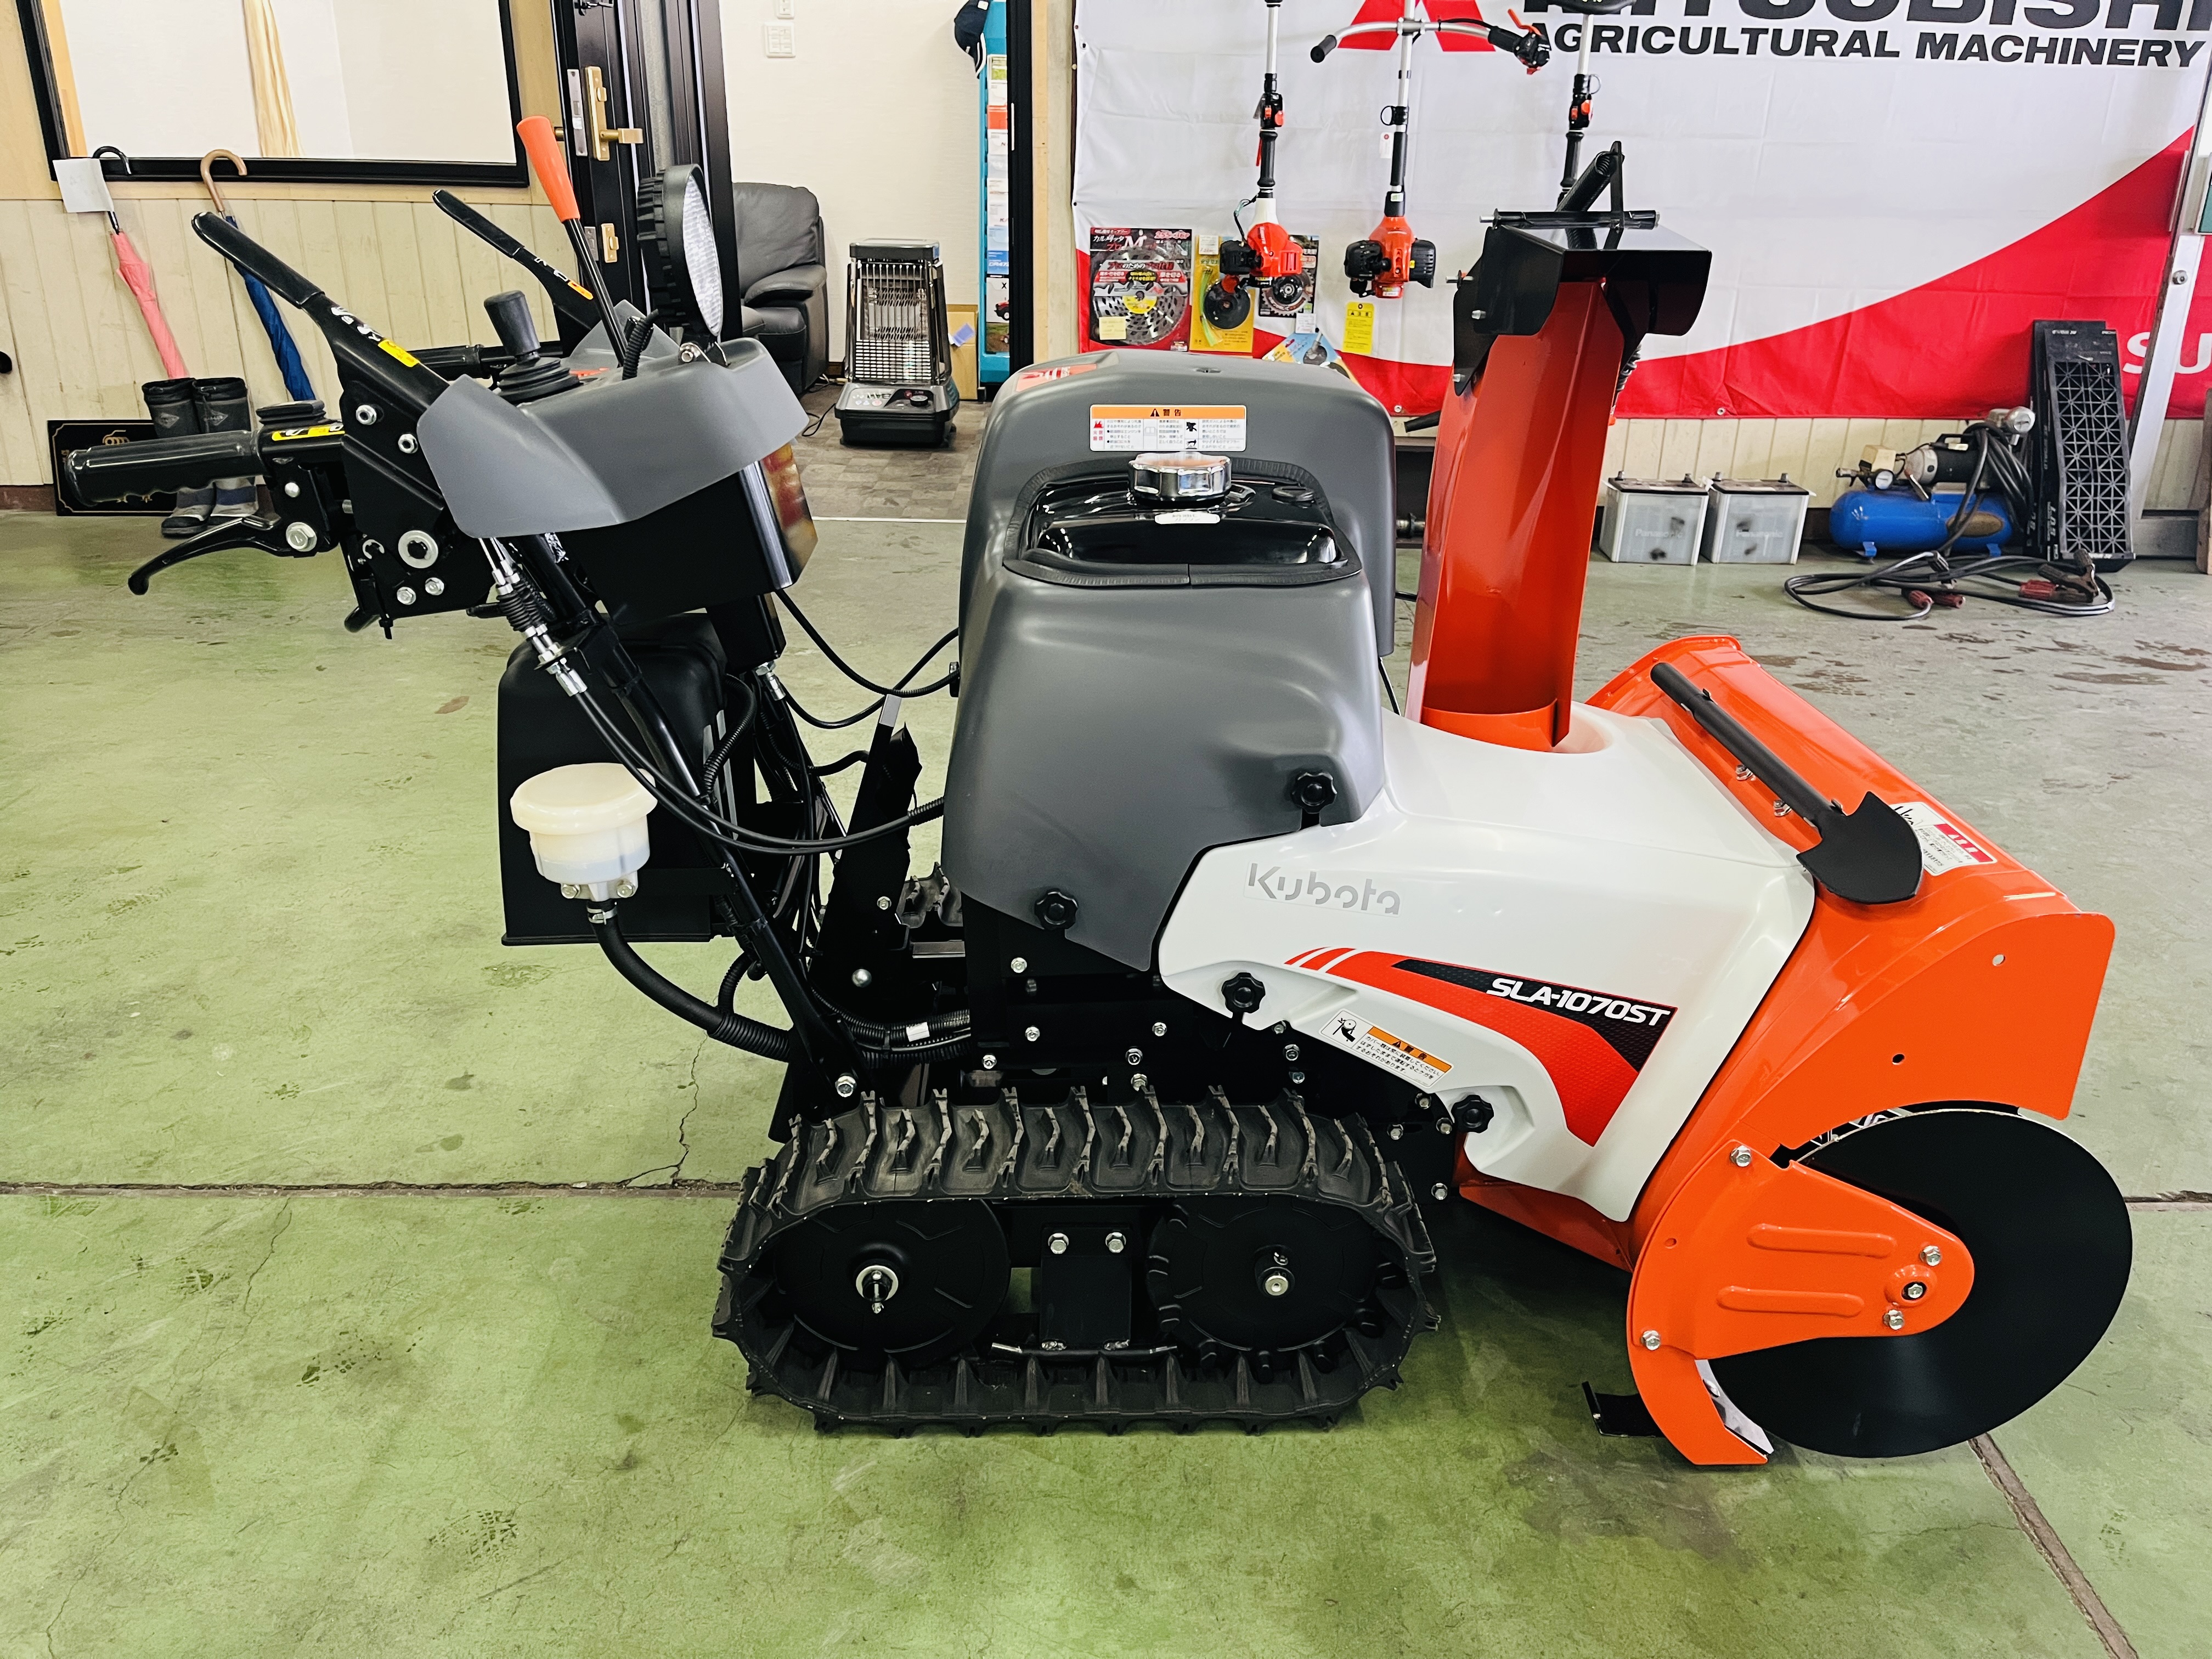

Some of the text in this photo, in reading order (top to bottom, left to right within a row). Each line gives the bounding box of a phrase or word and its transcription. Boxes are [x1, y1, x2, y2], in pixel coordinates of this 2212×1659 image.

[1915, 31, 2206, 67] MACHINERY
[1248, 863, 1400, 915] Kubota
[1486, 978, 1671, 1026] SLA-1070ST
